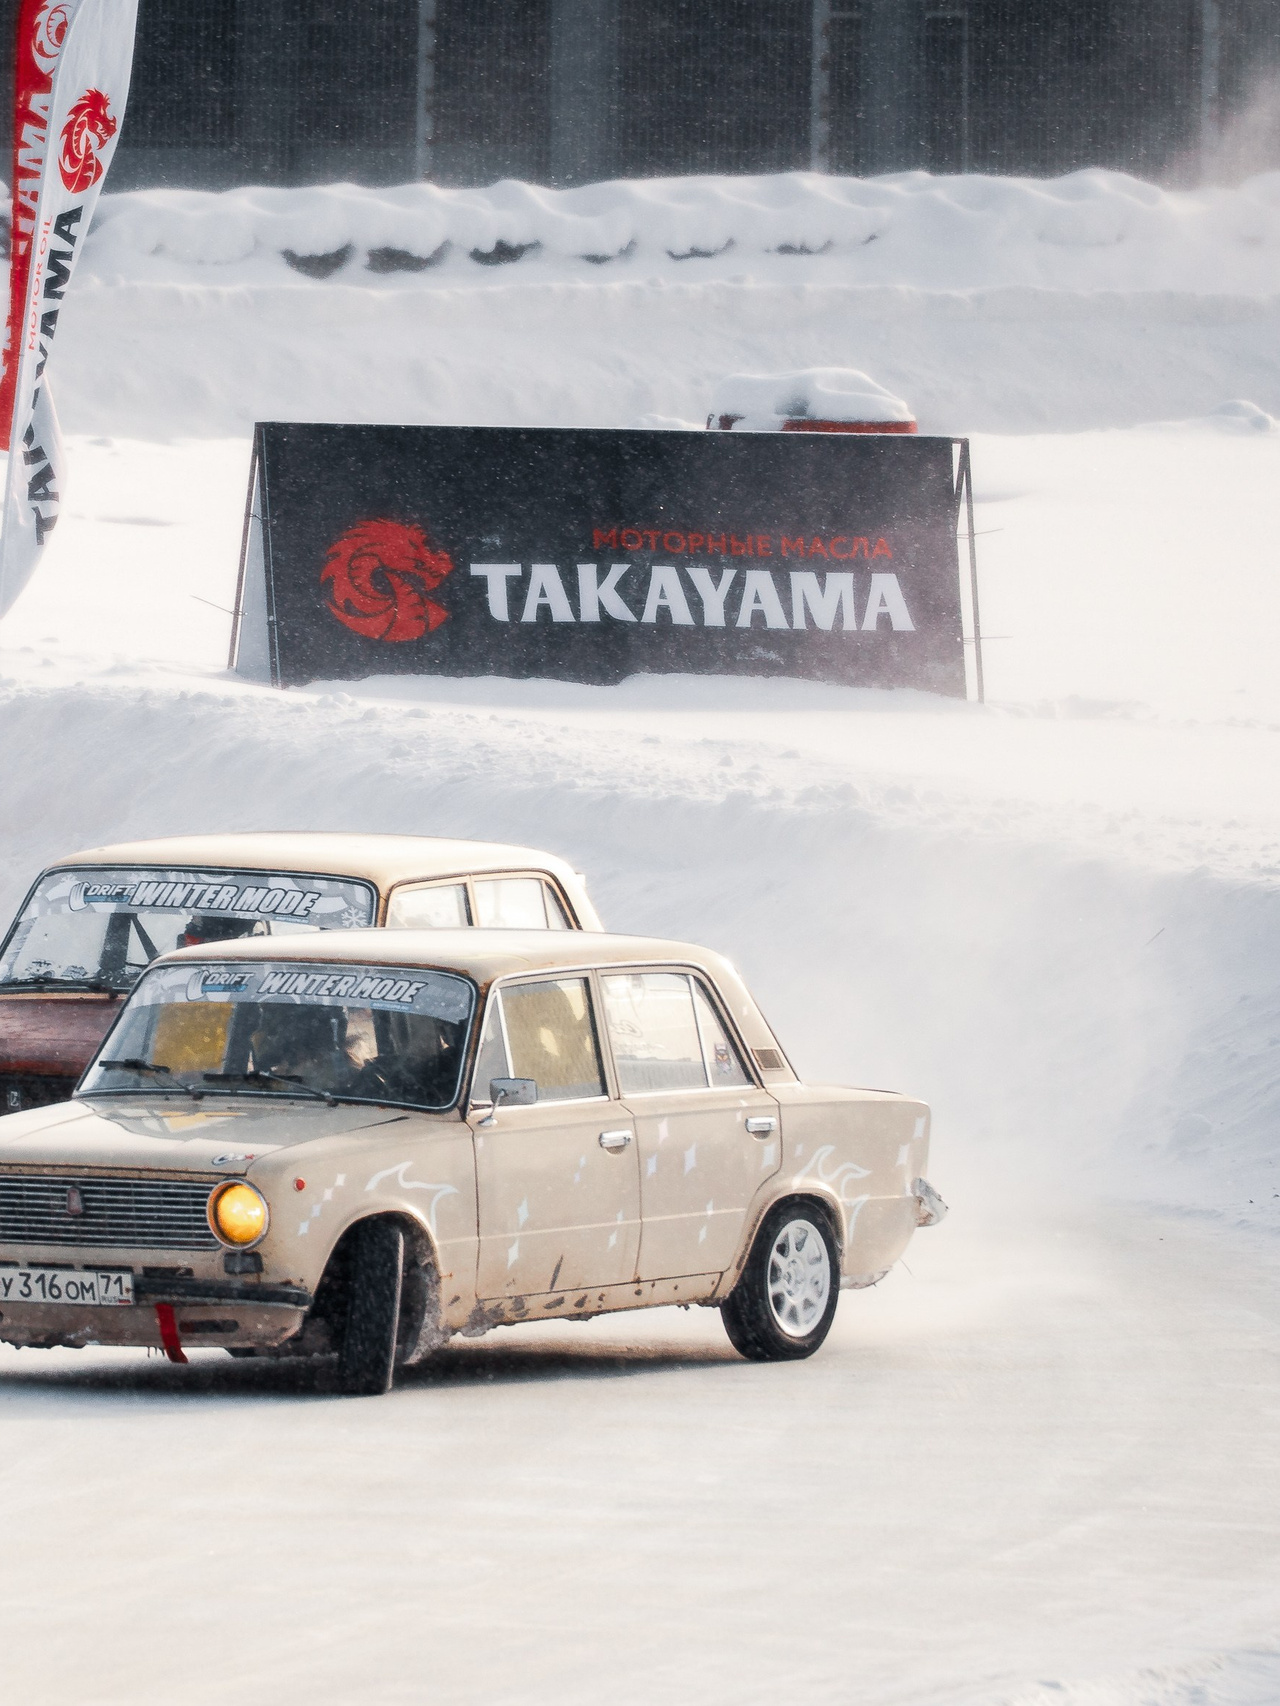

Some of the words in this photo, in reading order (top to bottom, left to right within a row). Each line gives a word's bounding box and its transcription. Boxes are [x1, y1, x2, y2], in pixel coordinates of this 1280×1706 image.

[592, 527, 772, 557] МОТОРНЫЕ
[780, 536, 893, 560] МАСЛА
[470, 562, 916, 631] TAKAYAMA
[86, 883, 136, 896] DRIFT
[128, 881, 242, 911] WINTER
[231, 886, 322, 917] MODE
[204, 972, 255, 985] DRIFT
[257, 971, 357, 998] WINTER
[350, 975, 429, 1003] MODE
[99, 1274, 124, 1296] 71
